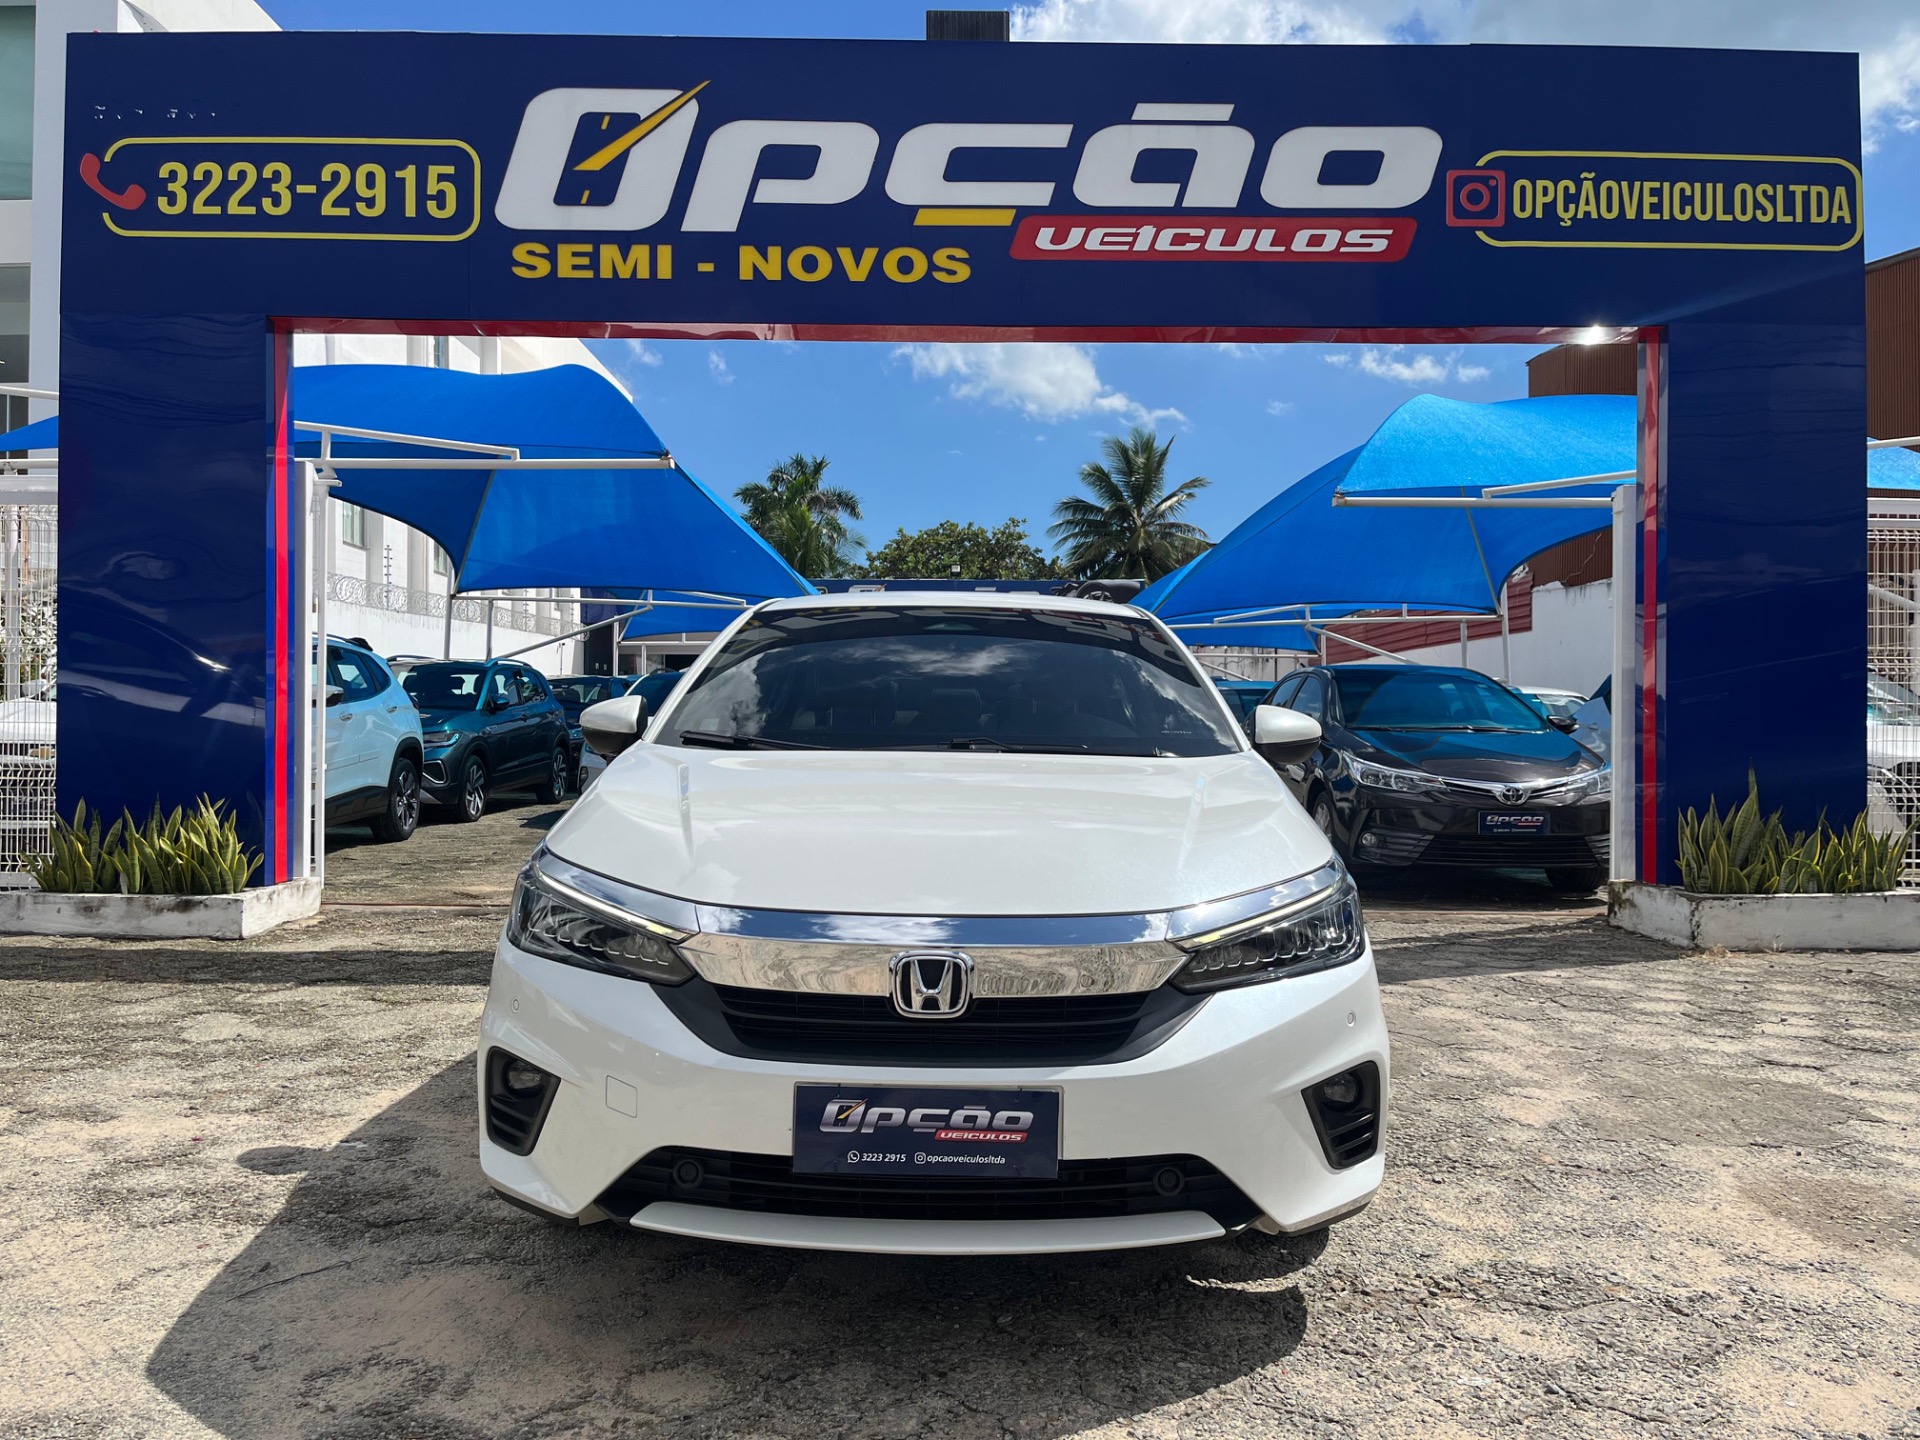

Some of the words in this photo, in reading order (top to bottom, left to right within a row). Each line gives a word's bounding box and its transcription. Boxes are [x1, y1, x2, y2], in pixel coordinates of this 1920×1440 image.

[157, 161, 457, 219] 3223-2915
[1512, 172, 1852, 227] OPÇÃOVEICULOSLTDA
[511, 242, 673, 280] SEMI
[739, 245, 972, 284] NOVOS
[861, 1153, 883, 1162] 3223
[884, 1153, 907, 1163] 2915
[926, 1154, 1006, 1165] opcaoveiculosltda
